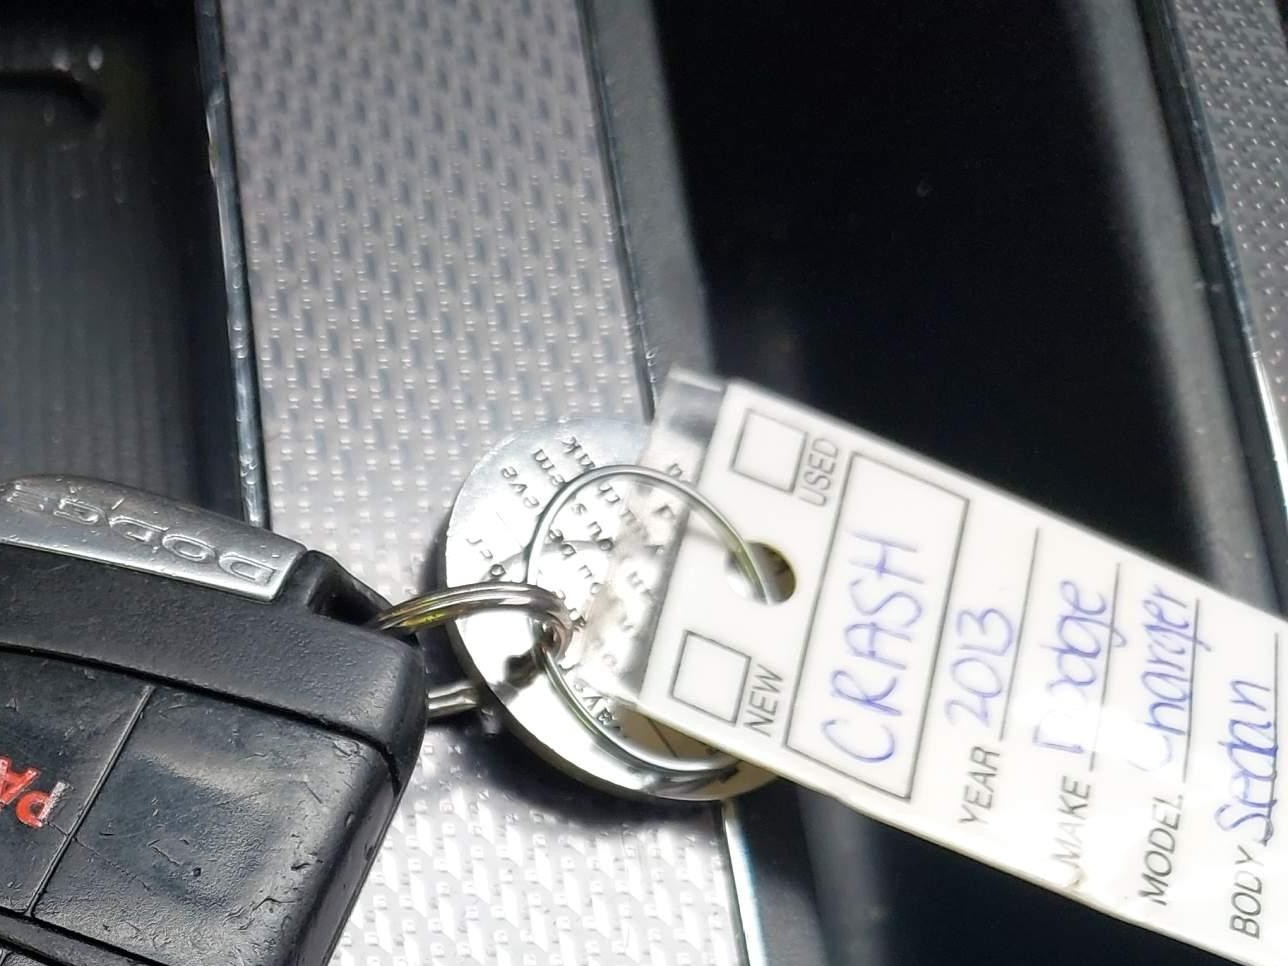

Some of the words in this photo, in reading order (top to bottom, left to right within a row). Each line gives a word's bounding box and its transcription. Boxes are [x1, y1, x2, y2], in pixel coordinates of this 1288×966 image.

[560, 436, 621, 505] thnk
[797, 436, 841, 507] USED
[12, 482, 279, 583] DODGE
[821, 529, 924, 764] CRASH
[945, 607, 1015, 730] 2013
[743, 665, 785, 737] NEW
[960, 746, 1001, 827] YEAR
[1214, 679, 1279, 846] Sedan
[1051, 776, 1091, 866] MAKE
[1139, 796, 1184, 906] MODEL
[1229, 845, 1266, 939] BODY
